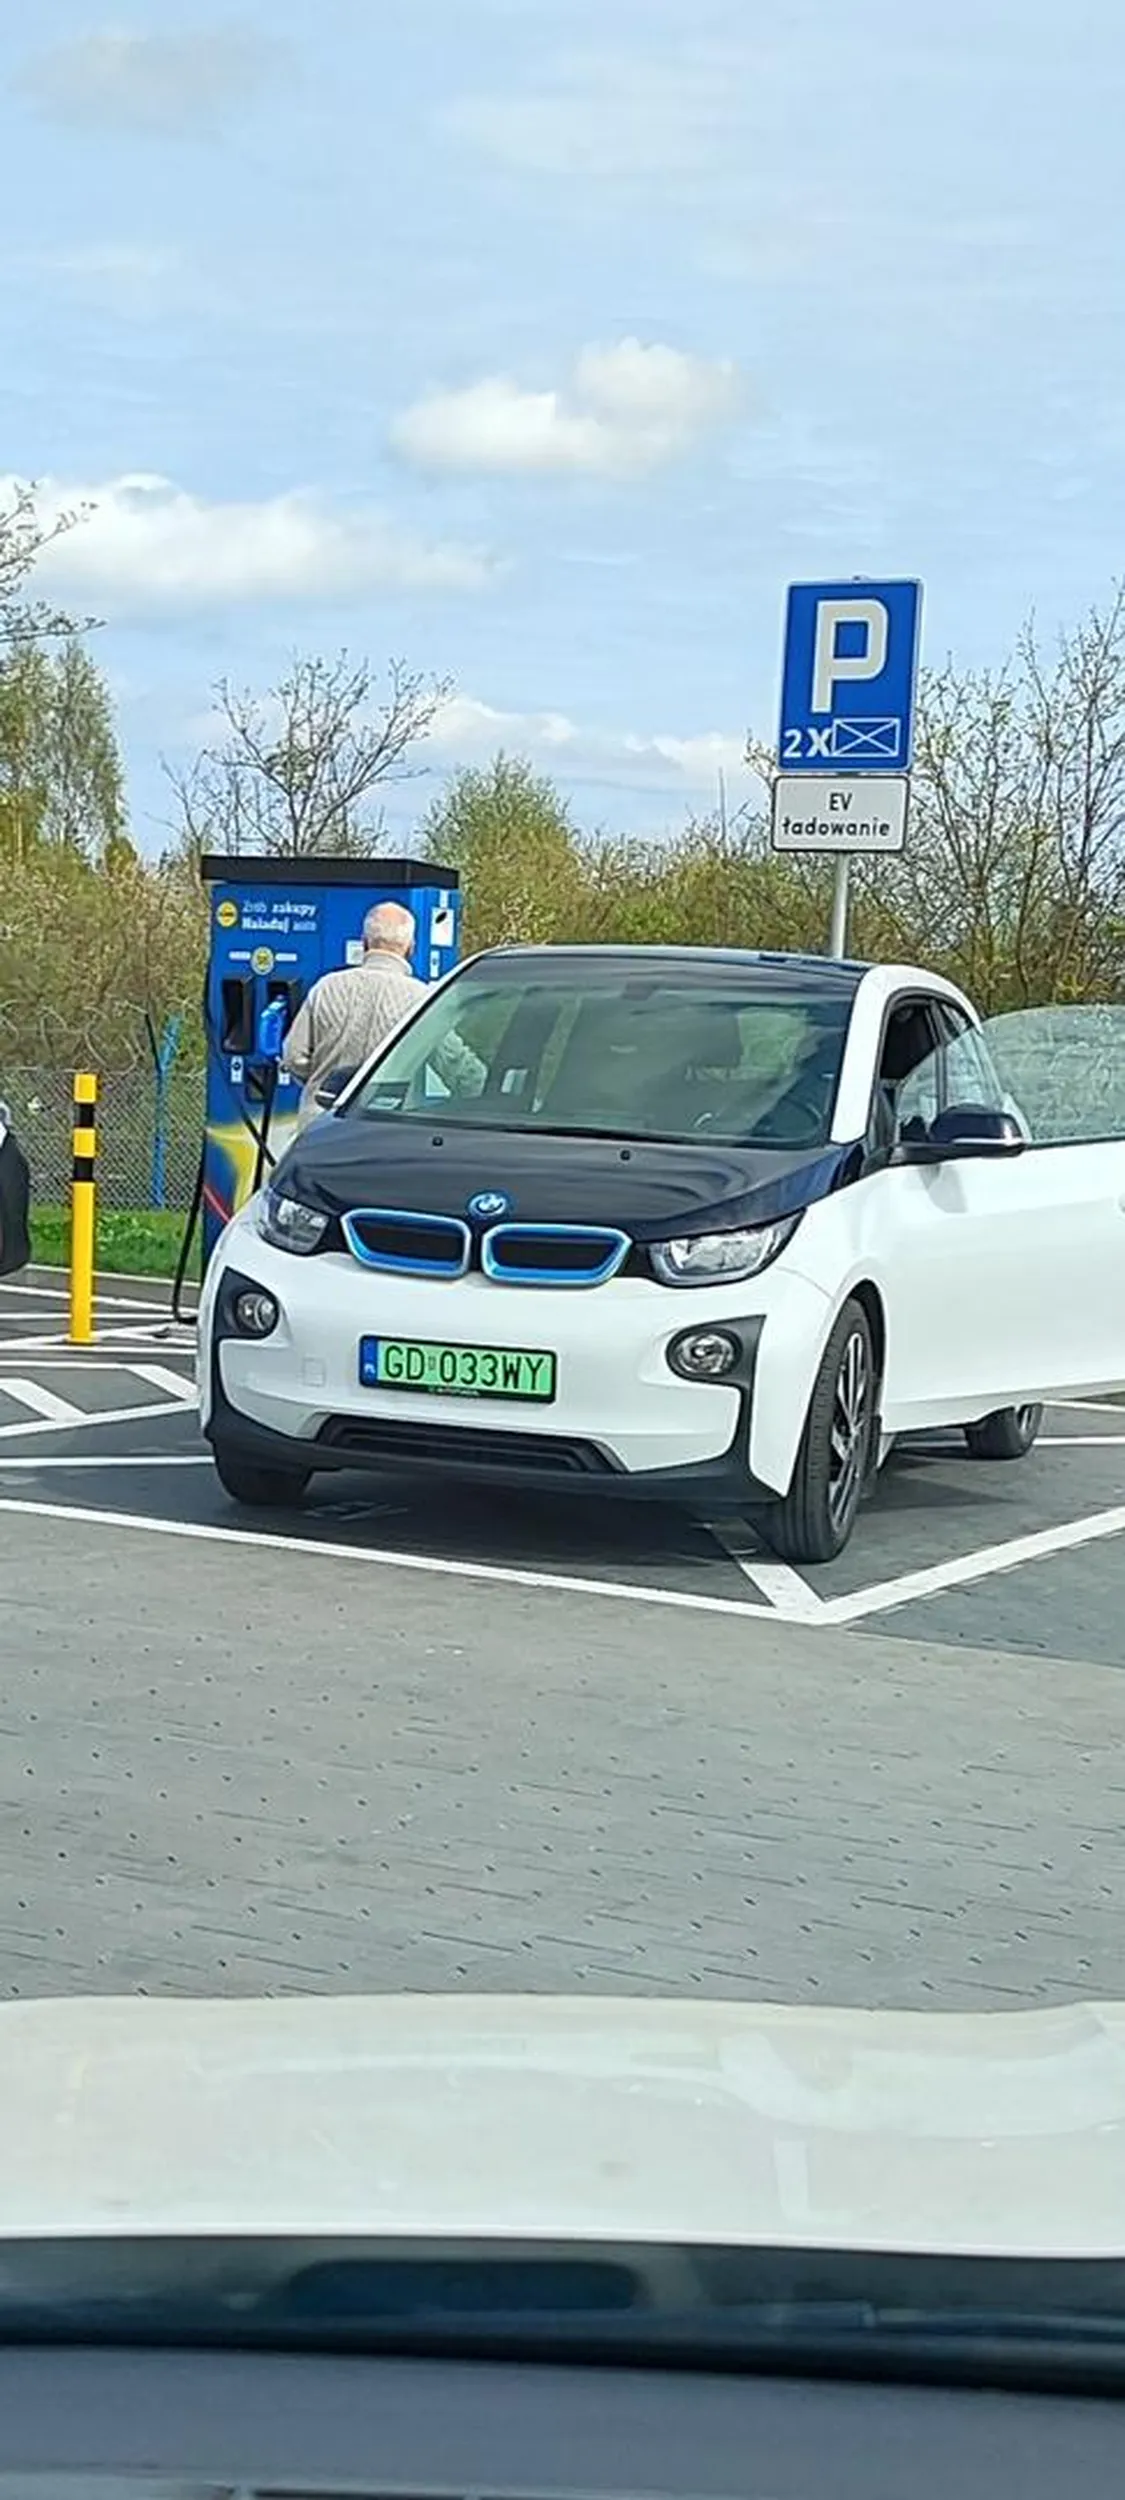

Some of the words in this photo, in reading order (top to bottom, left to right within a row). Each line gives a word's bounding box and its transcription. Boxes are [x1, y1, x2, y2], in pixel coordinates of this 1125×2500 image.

[811, 599, 889, 714] P
[829, 792, 853, 811] EV
[782, 816, 891, 837] ładowanie
[385, 1345, 425, 1380] GD
[439, 1350, 544, 1391] 033WY
